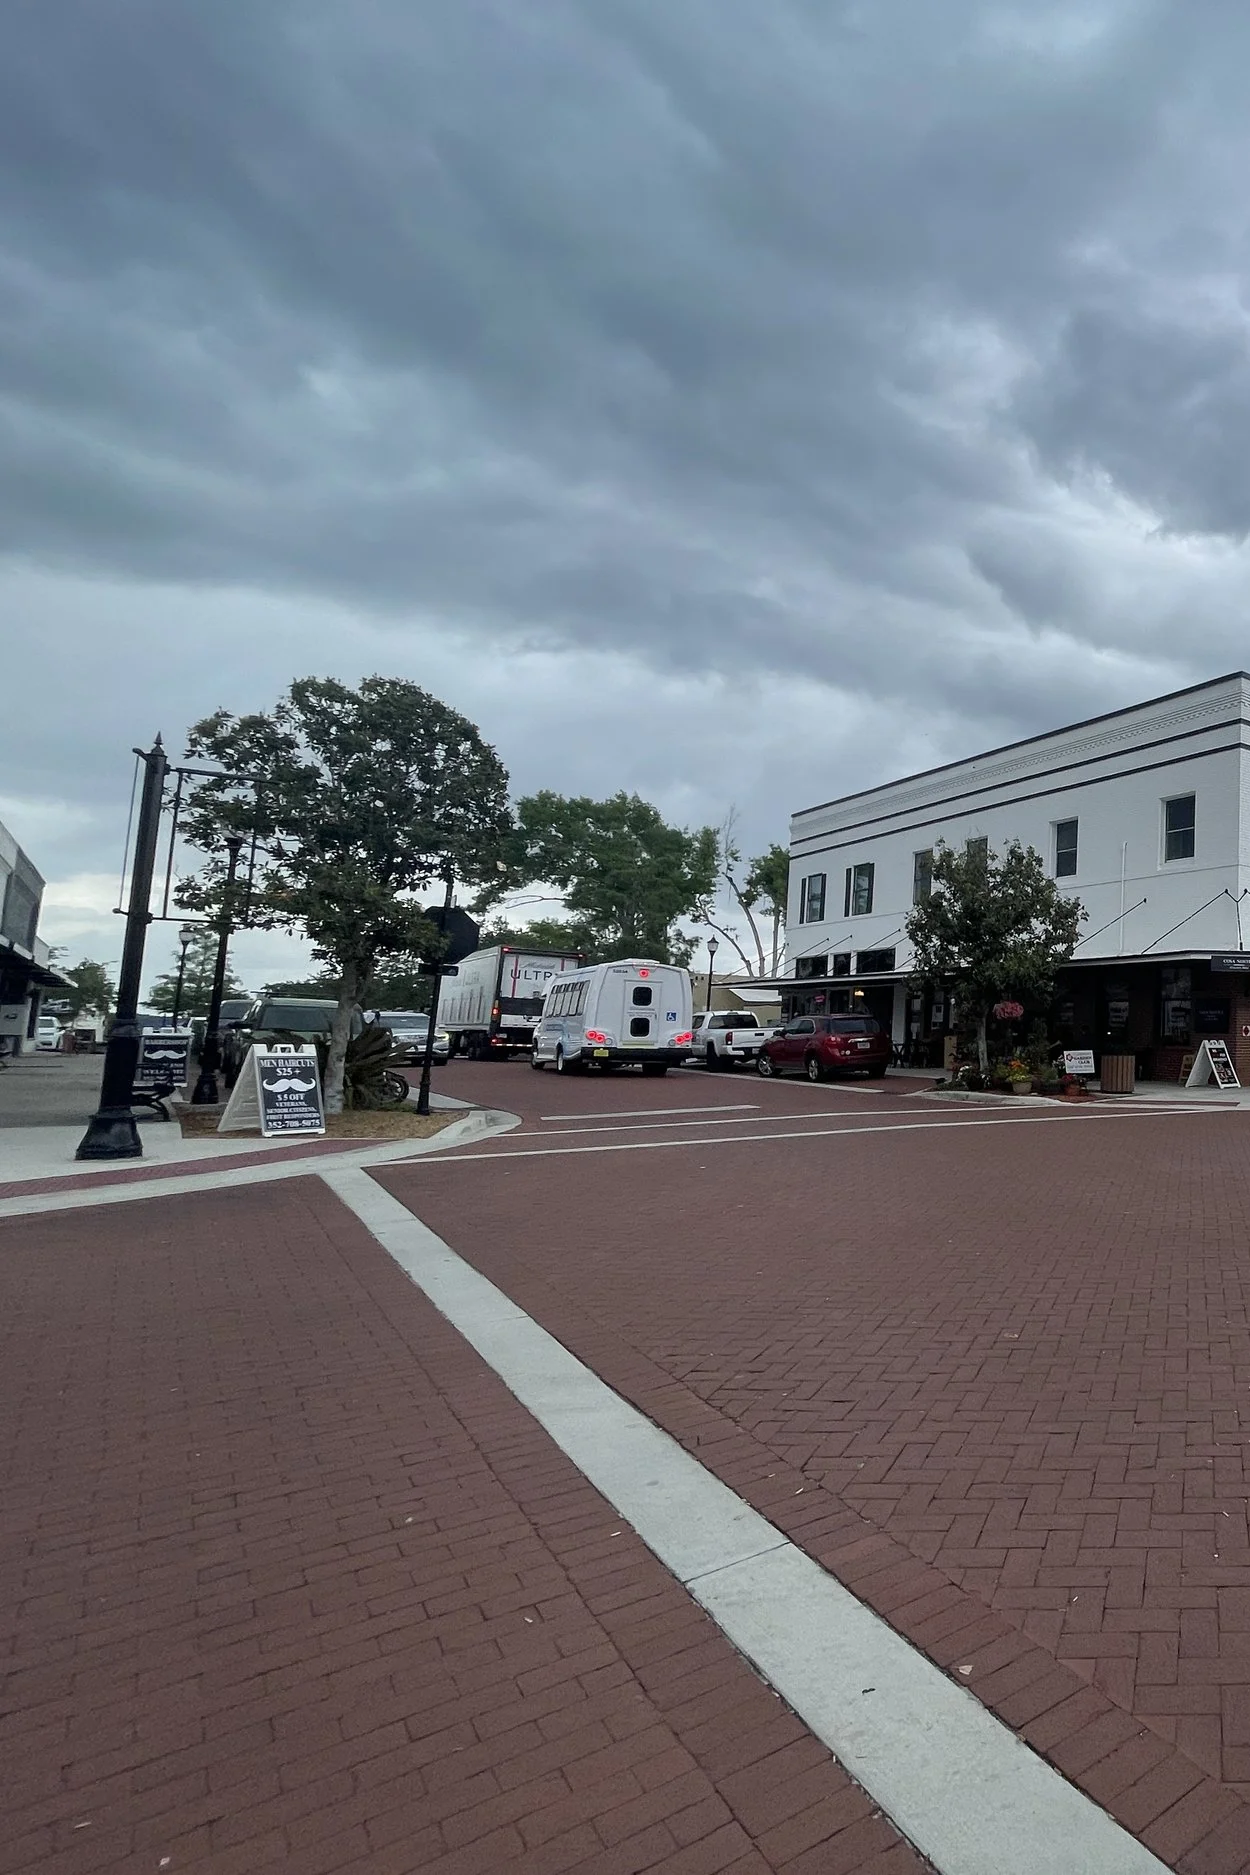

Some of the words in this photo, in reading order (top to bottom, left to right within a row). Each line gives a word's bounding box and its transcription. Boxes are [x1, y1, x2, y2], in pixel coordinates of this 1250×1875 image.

[511, 969, 556, 981] ULTR
[260, 1059, 277, 1068] MEN
[279, 1059, 315, 1067] HAIRCUTS
[276, 1067, 293, 1076] $25
[289, 1093, 305, 1101] OFF
